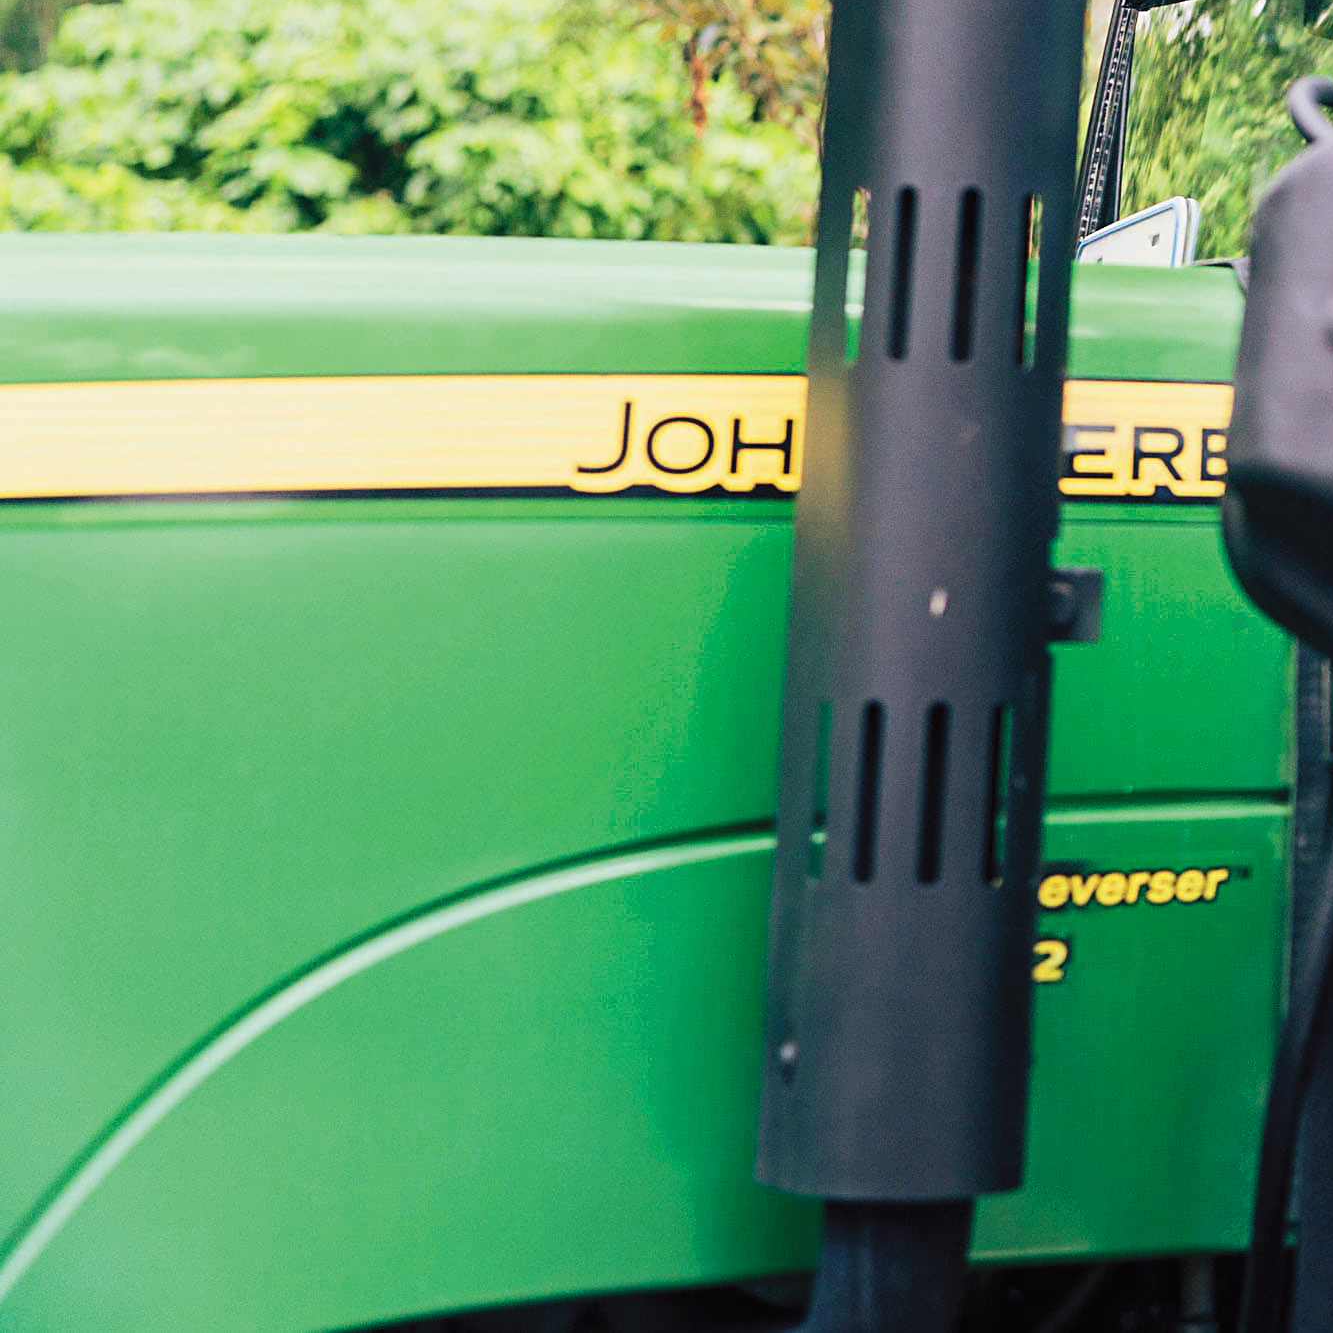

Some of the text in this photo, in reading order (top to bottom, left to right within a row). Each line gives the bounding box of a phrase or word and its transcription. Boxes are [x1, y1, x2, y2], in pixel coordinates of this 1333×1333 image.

[577, 401, 1228, 481] JOH ERE
[1037, 867, 1230, 909] everser
